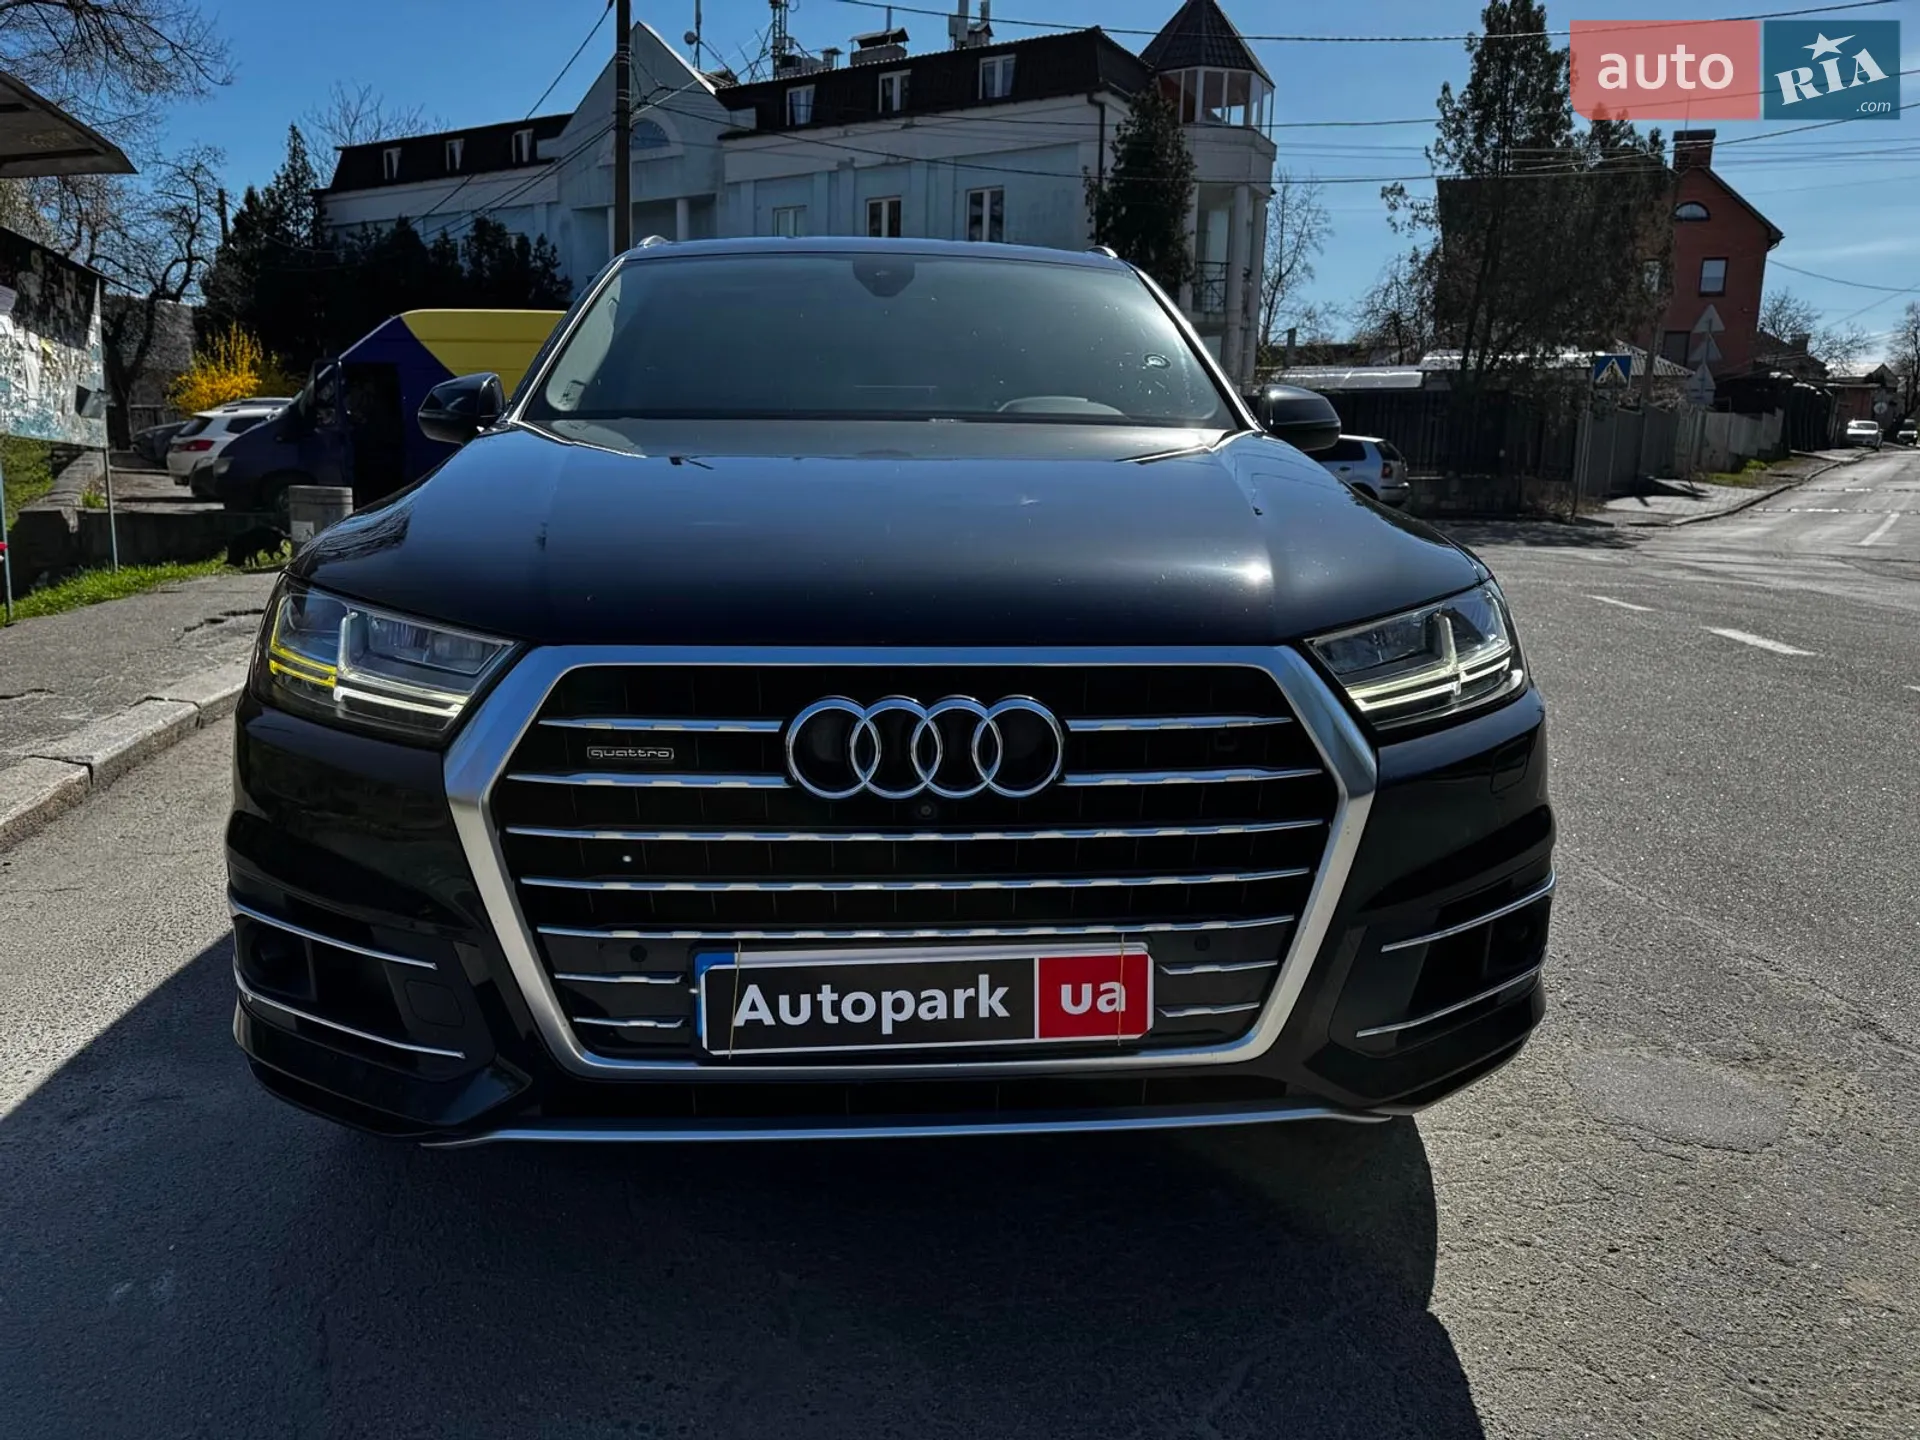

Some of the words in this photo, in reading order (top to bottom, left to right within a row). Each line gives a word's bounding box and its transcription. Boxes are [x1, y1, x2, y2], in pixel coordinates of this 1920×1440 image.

[590, 748, 670, 758] quattro
[732, 974, 1010, 1035] Autopark
[1060, 980, 1126, 1016] ua
